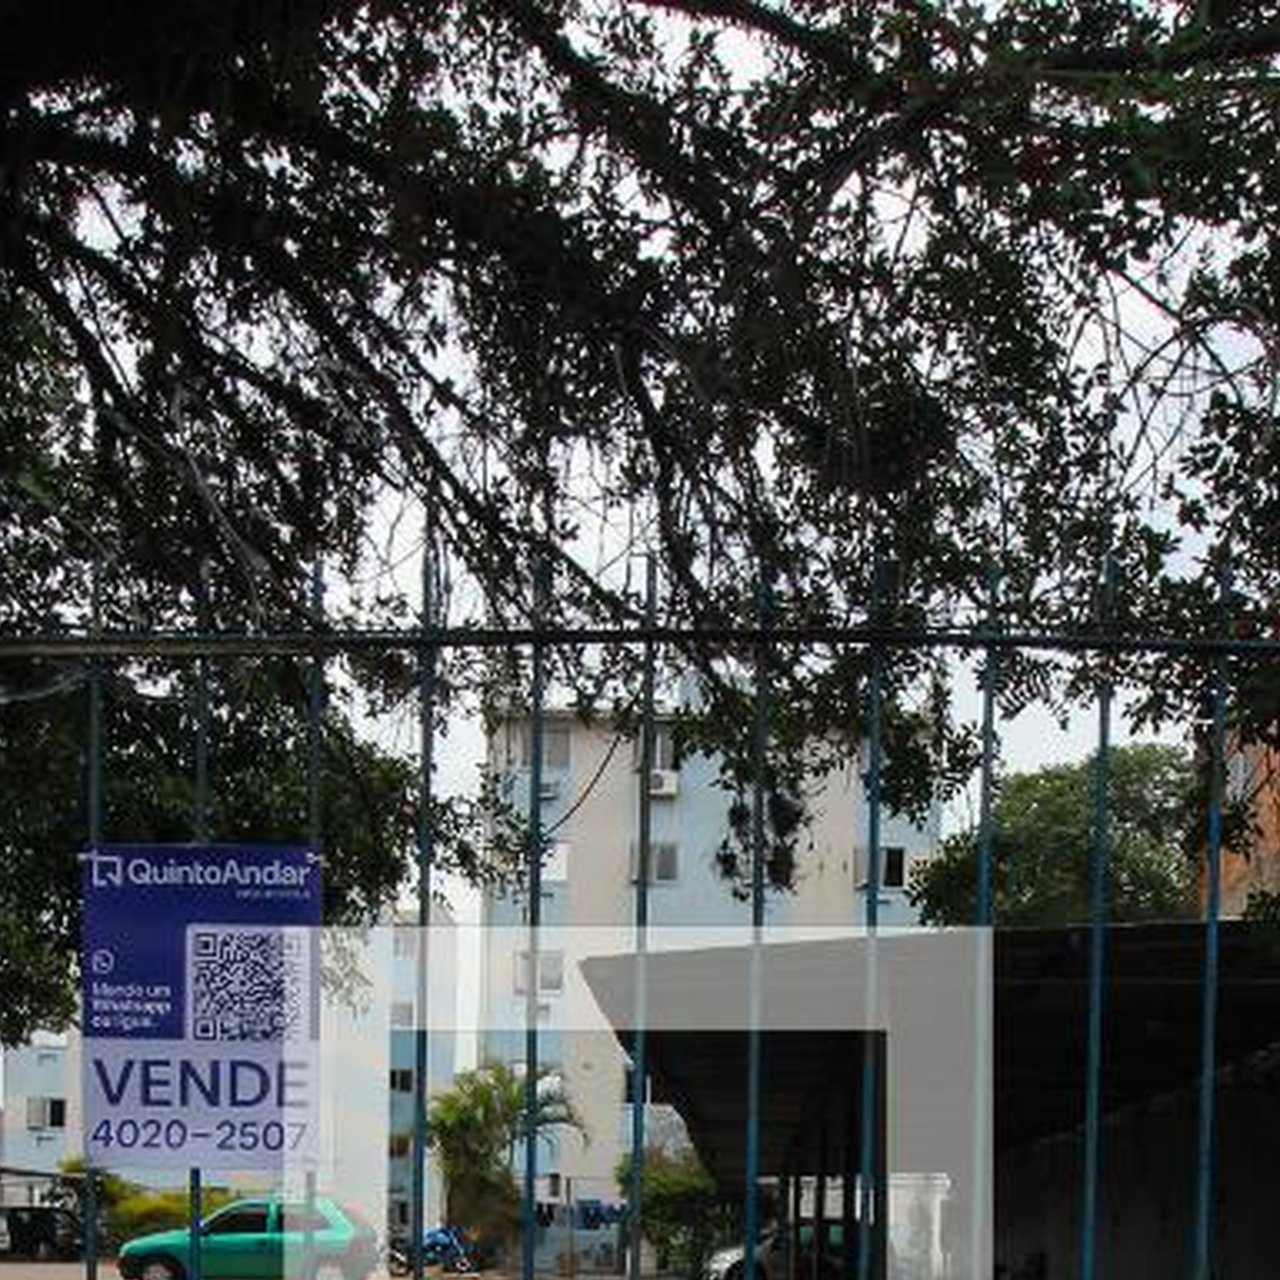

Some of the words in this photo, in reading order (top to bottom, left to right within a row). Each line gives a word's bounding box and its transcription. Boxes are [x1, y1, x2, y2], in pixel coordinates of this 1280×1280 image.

[127, 859, 311, 885] QuintoAndar
[93, 1059, 308, 1108] VENDE
[91, 1119, 308, 1151] 4020-2507
